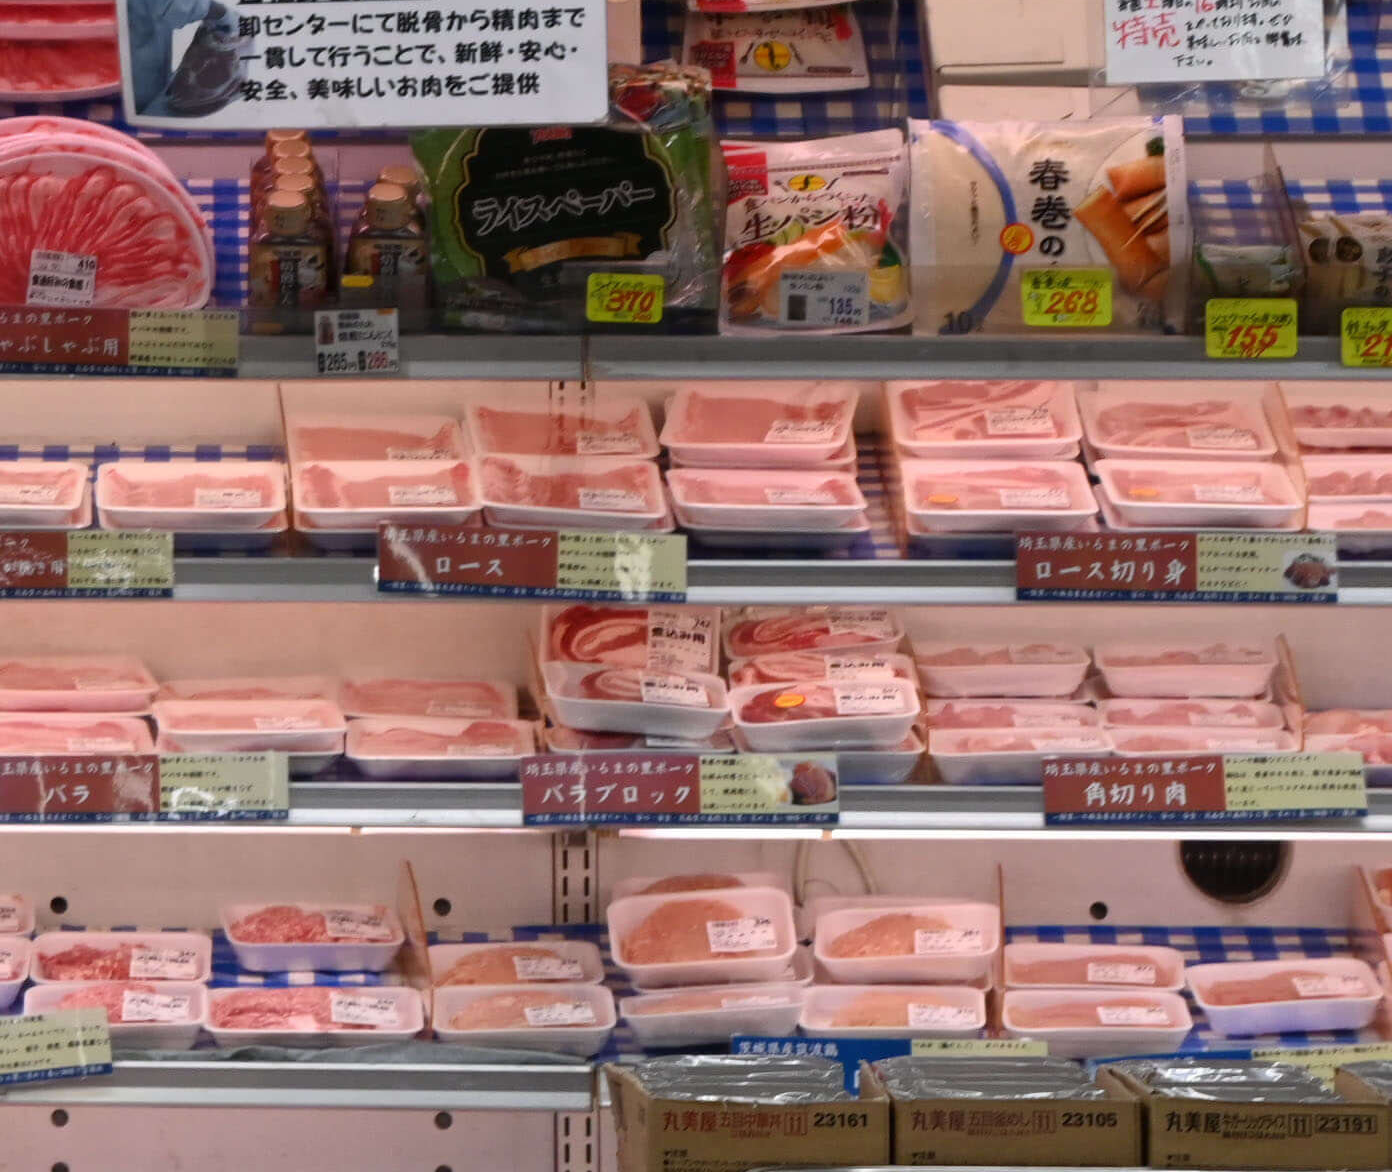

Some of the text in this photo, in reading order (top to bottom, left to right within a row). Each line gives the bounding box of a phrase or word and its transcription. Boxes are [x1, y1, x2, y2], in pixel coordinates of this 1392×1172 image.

[238, 6, 585, 38] 卸センターにて脱骨から精肉まで
[239, 39, 580, 70] 一貫して行うことで、新鮮・安心・
[239, 73, 540, 102] 安全、美味しいお肉をご提供
[472, 179, 656, 237] ライスペーパー
[1028, 158, 1072, 265] 春巻の
[741, 204, 881, 244] 生パン粉
[606, 289, 657, 313] 370
[1044, 289, 1101, 316] 268
[1226, 324, 1282, 350] 155
[435, 556, 505, 577] ロース
[1035, 558, 1188, 586] ロース切り身
[650, 627, 706, 645] 煮込み用
[44, 784, 92, 805] バラ
[542, 783, 692, 806] バラブロック
[1083, 780, 1188, 807] 角切り肉
[662, 1110, 717, 1133] 丸美屋
[813, 1112, 870, 1129] 23161
[911, 1109, 966, 1132] 丸美屋
[1061, 1112, 1117, 1128] 23105
[1166, 1110, 1221, 1133] 丸美屋
[1318, 1115, 1376, 1134] 23191
